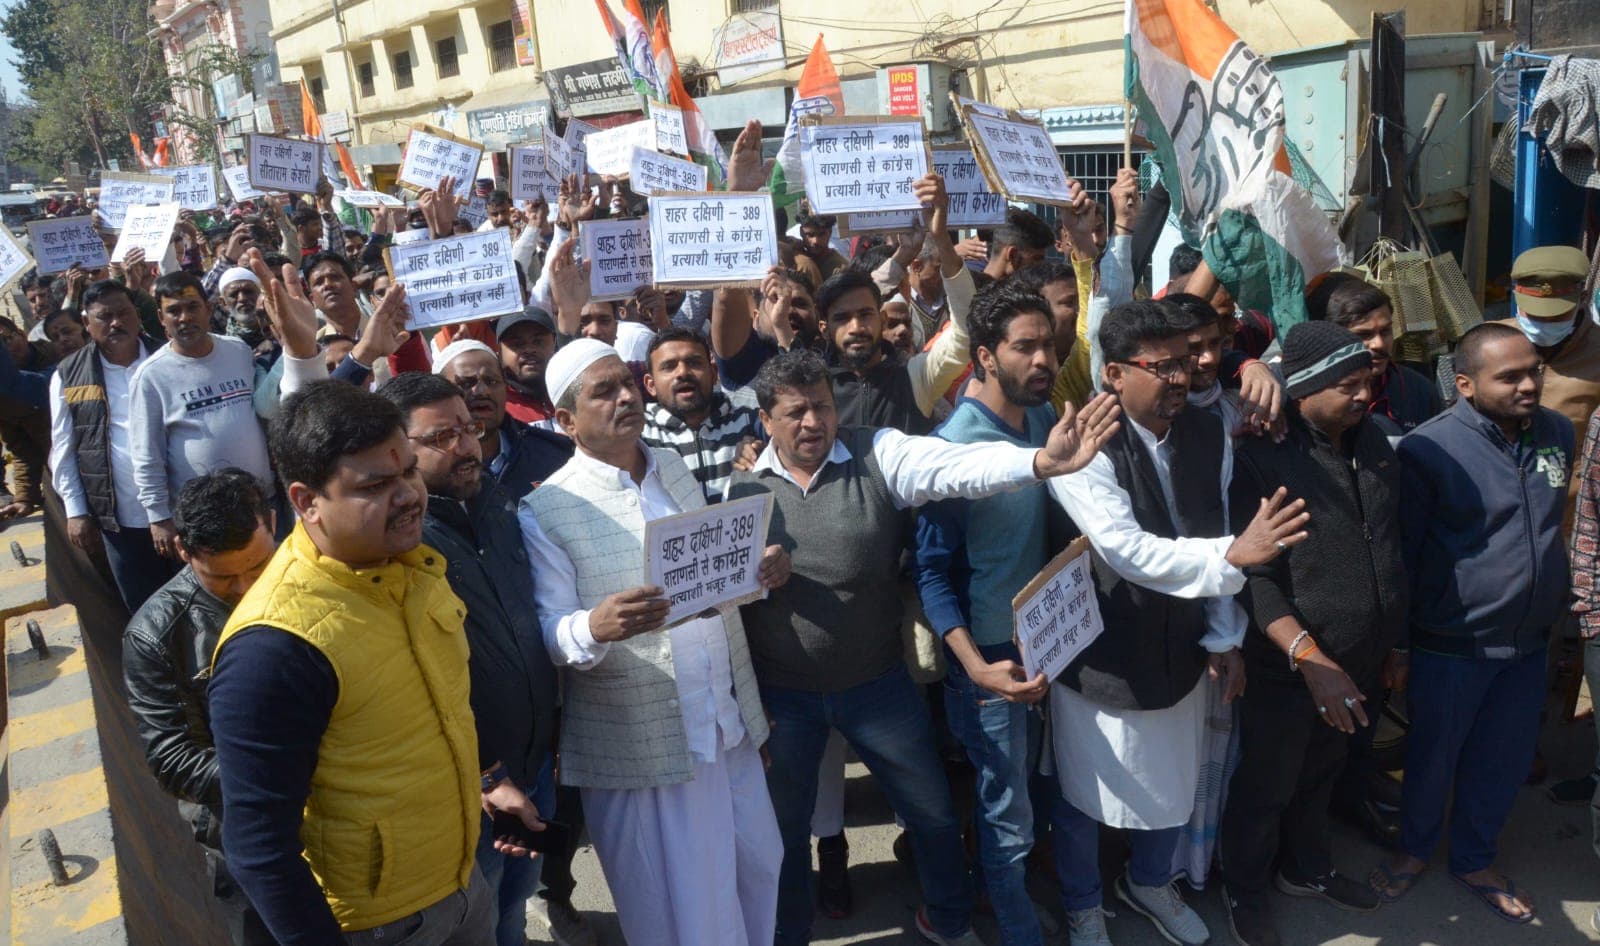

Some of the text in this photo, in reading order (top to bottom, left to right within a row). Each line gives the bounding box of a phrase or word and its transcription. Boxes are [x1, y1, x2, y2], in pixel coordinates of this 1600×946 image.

[564, 74, 577, 93] श्री
[576, 72, 601, 91] गणेश
[891, 72, 914, 84] IPDS
[480, 113, 504, 132] गणपति
[260, 144, 272, 157] शहर
[275, 144, 292, 160] दक्षिणी
[302, 152, 312, 162] 389
[816, 138, 838, 153] शहर
[843, 130, 874, 152] दक्षिणी
[892, 134, 910, 150] 389
[260, 159, 287, 183] सीताराम
[290, 162, 311, 184] केशरी
[820, 154, 914, 176] वाराणसी से कांग्रेस
[825, 176, 914, 199] प्रत्याशी मंजूर नहीं
[664, 208, 688, 222] शहर
[693, 202, 724, 222] दक्षिणी
[742, 206, 760, 220] 389
[597, 236, 616, 254] शहर
[619, 228, 643, 251] दक्षिणी
[668, 226, 762, 244] वाराणसी से कांग्रेस
[408, 253, 429, 271] शहर
[434, 242, 464, 266] दक्षिणी
[482, 242, 499, 258] 389
[598, 254, 628, 270] वाराणसी
[630, 252, 637, 268] से
[672, 247, 764, 269] प्रत्याशी मंजूर नहीं
[412, 263, 503, 292] वाराणसी से कांग्रेस
[604, 272, 632, 284] प्रत्याशी
[420, 283, 504, 312] प्रत्याशी मंजूर नहीं
[181, 384, 214, 402] TEAM
[662, 536, 686, 562] शहर
[690, 518, 723, 554] दक्षिणी
[664, 544, 752, 588] वाराणसी से कांग्रेस
[670, 568, 746, 607] प्रत्याशी मंजूर नहीं
[1026, 604, 1044, 630] शहर
[1042, 580, 1064, 614] दक्षिणी
[1071, 566, 1084, 588] 389
[1032, 590, 1088, 650] वाराणसी से कांग्रेस
[1038, 608, 1092, 671] प्रत्याशी मंजूर नहीं
